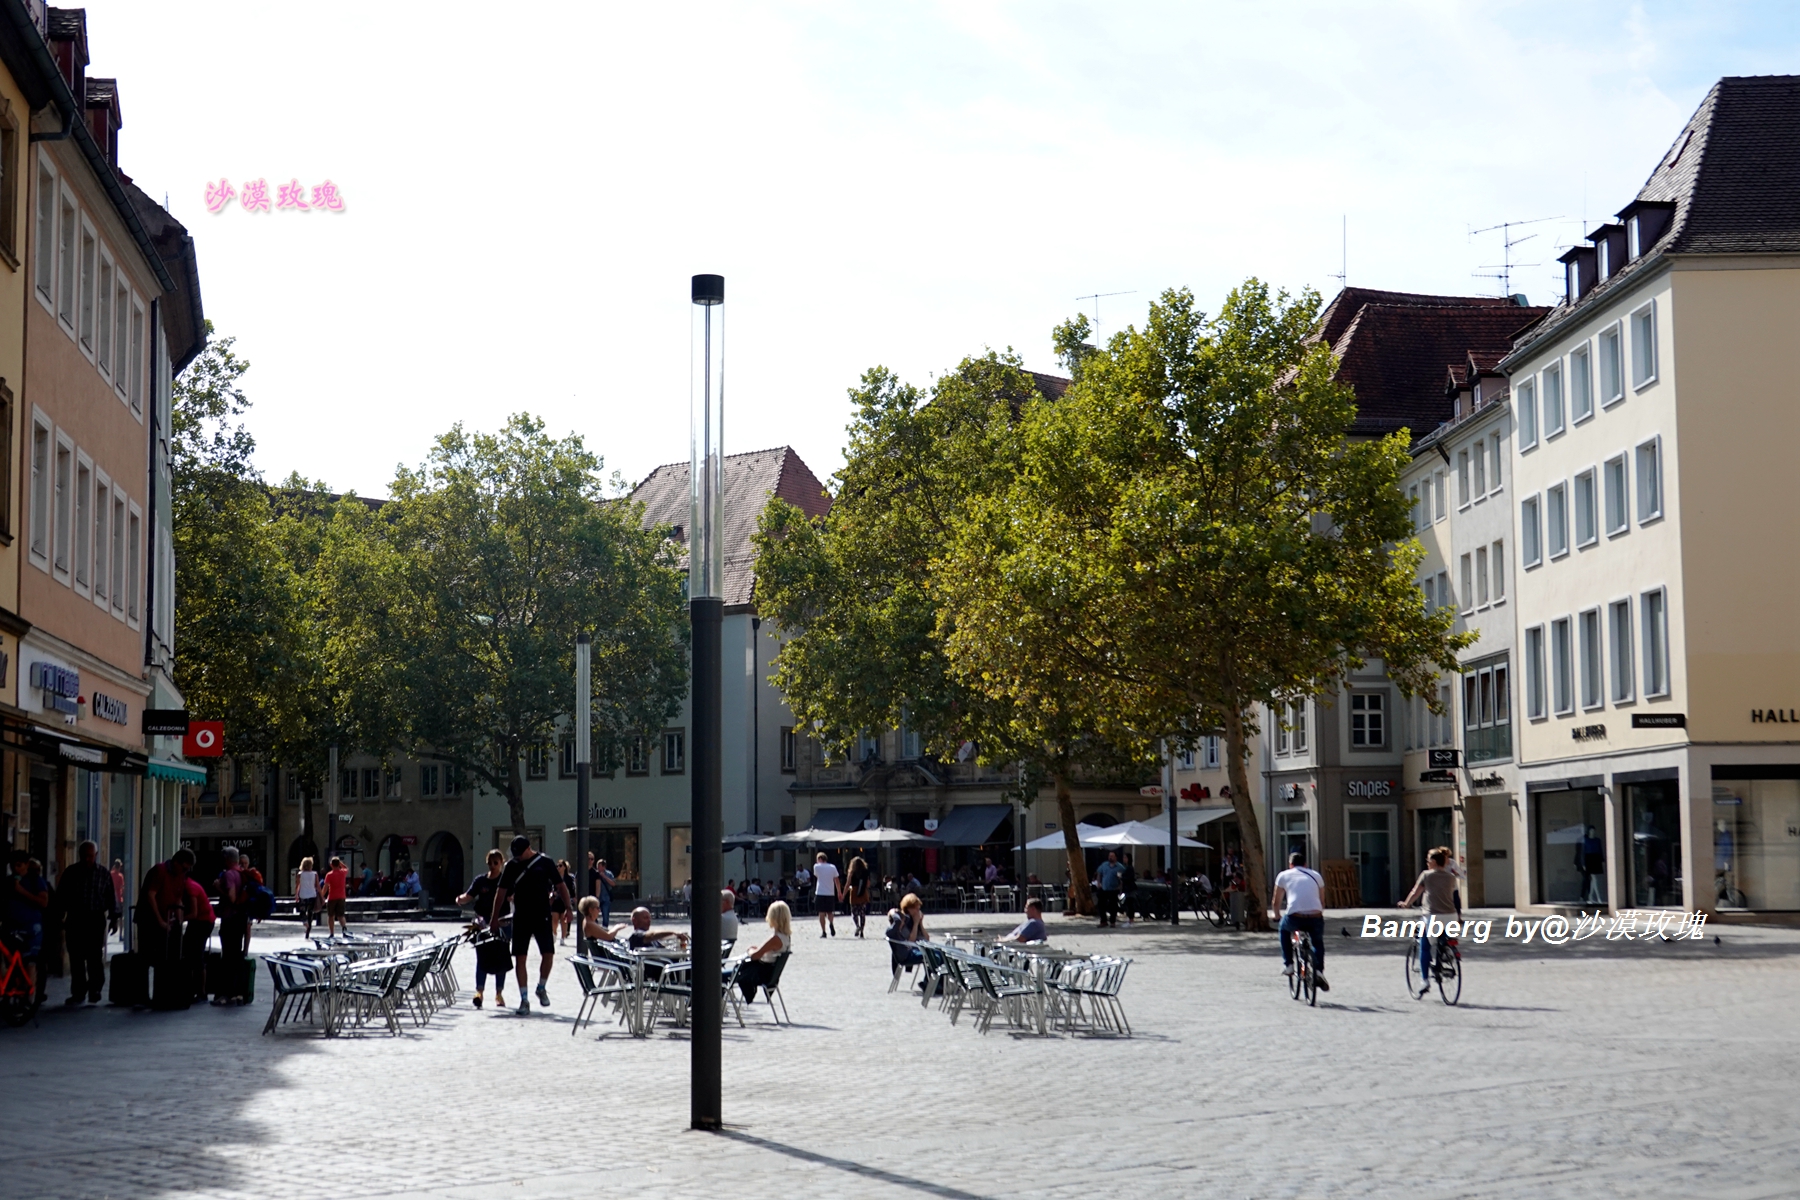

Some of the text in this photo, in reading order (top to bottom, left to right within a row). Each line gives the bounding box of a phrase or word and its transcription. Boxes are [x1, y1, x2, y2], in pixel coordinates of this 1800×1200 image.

[1751, 709, 1800, 723] HALL
[1348, 780, 1391, 799] snipes
[338, 814, 354, 824] mey
[221, 839, 253, 849] OLYMP
